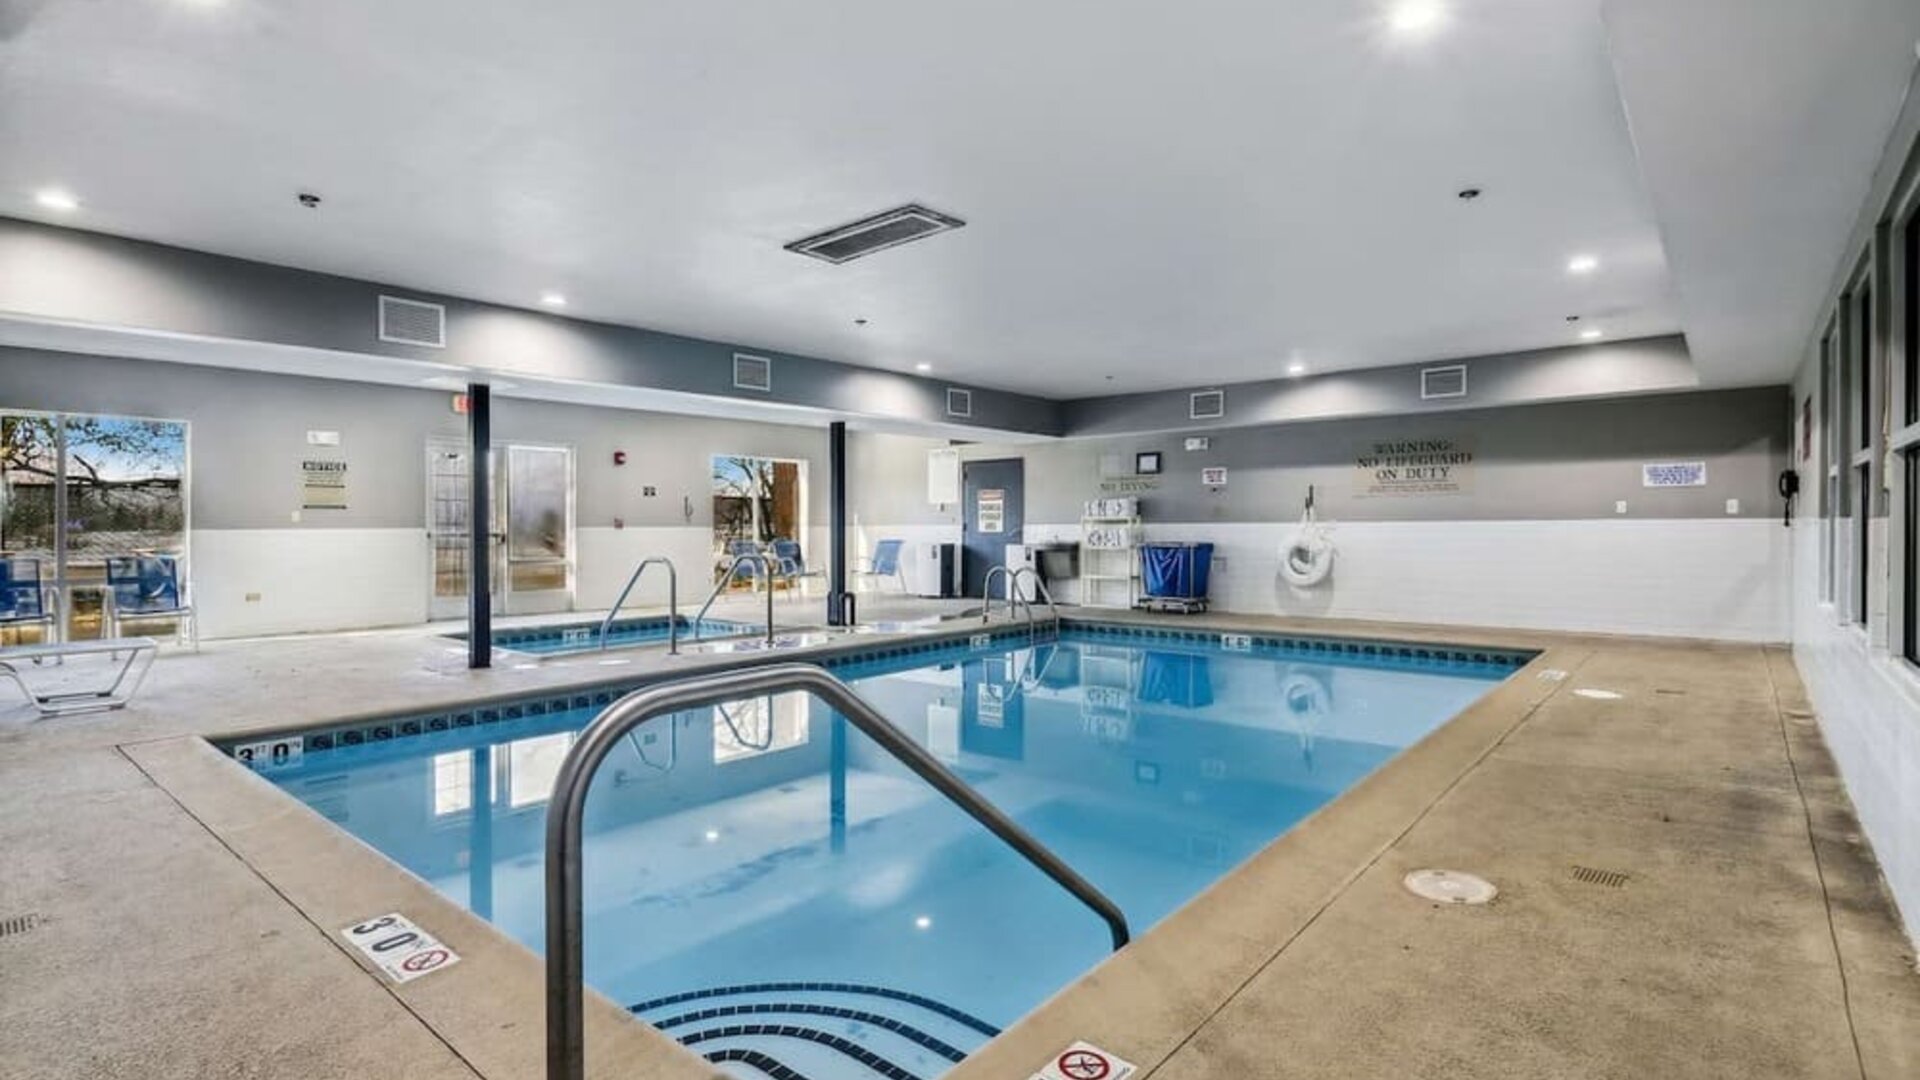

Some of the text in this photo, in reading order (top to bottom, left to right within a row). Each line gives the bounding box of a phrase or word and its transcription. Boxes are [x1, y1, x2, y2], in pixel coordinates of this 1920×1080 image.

[1357, 453, 1472, 468] NO LIFEGUARD
[1376, 467, 1450, 480] ON DUTY
